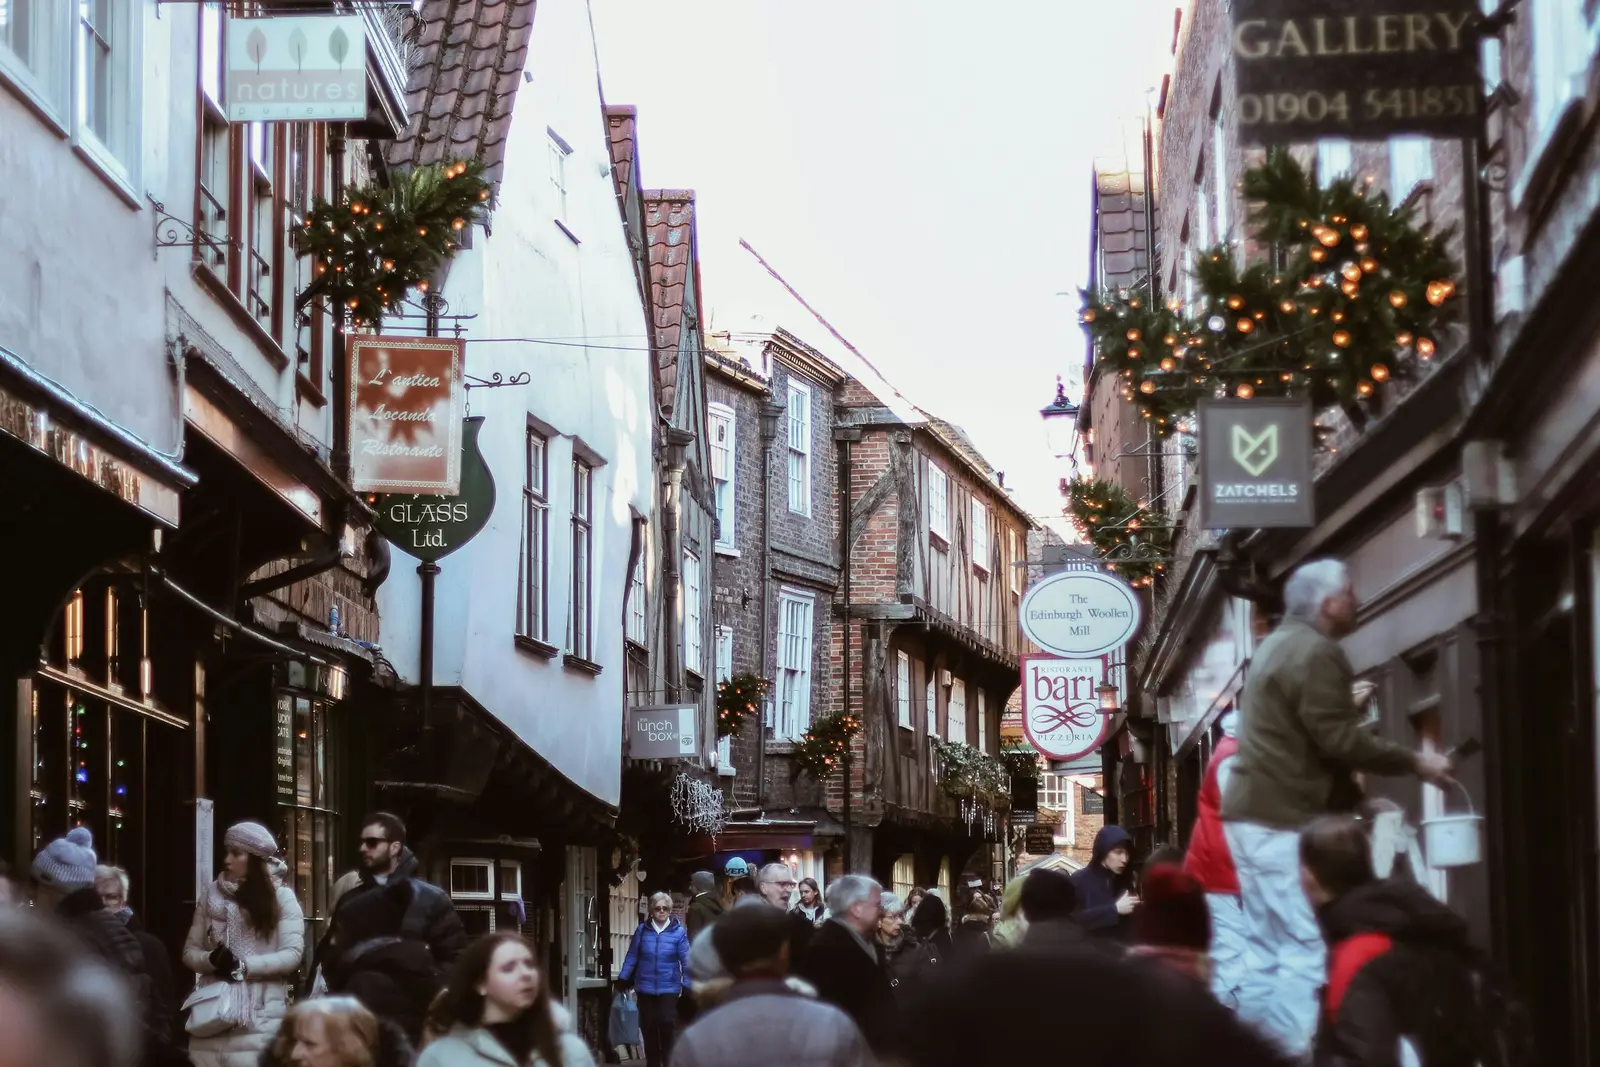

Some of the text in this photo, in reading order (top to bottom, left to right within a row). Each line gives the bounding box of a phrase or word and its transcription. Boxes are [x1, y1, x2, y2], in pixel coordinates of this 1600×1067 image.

[1234, 12, 1470, 59] GALLERY
[237, 78, 357, 100] natures
[1236, 84, 1478, 124] 01904 541851
[367, 403, 438, 422] Locanda
[361, 438, 444, 458] Ristorante
[1215, 484, 1298, 497] ZATCHELS
[390, 502, 469, 525] GLASS
[411, 528, 448, 548] Ltd.
[1069, 594, 1089, 604] The
[1030, 608, 1129, 622] Edinburgh Woollen
[1069, 625, 1091, 636] Mill
[1031, 666, 1098, 701] bari
[637, 719, 673, 732] lunch
[648, 731, 673, 742] box
